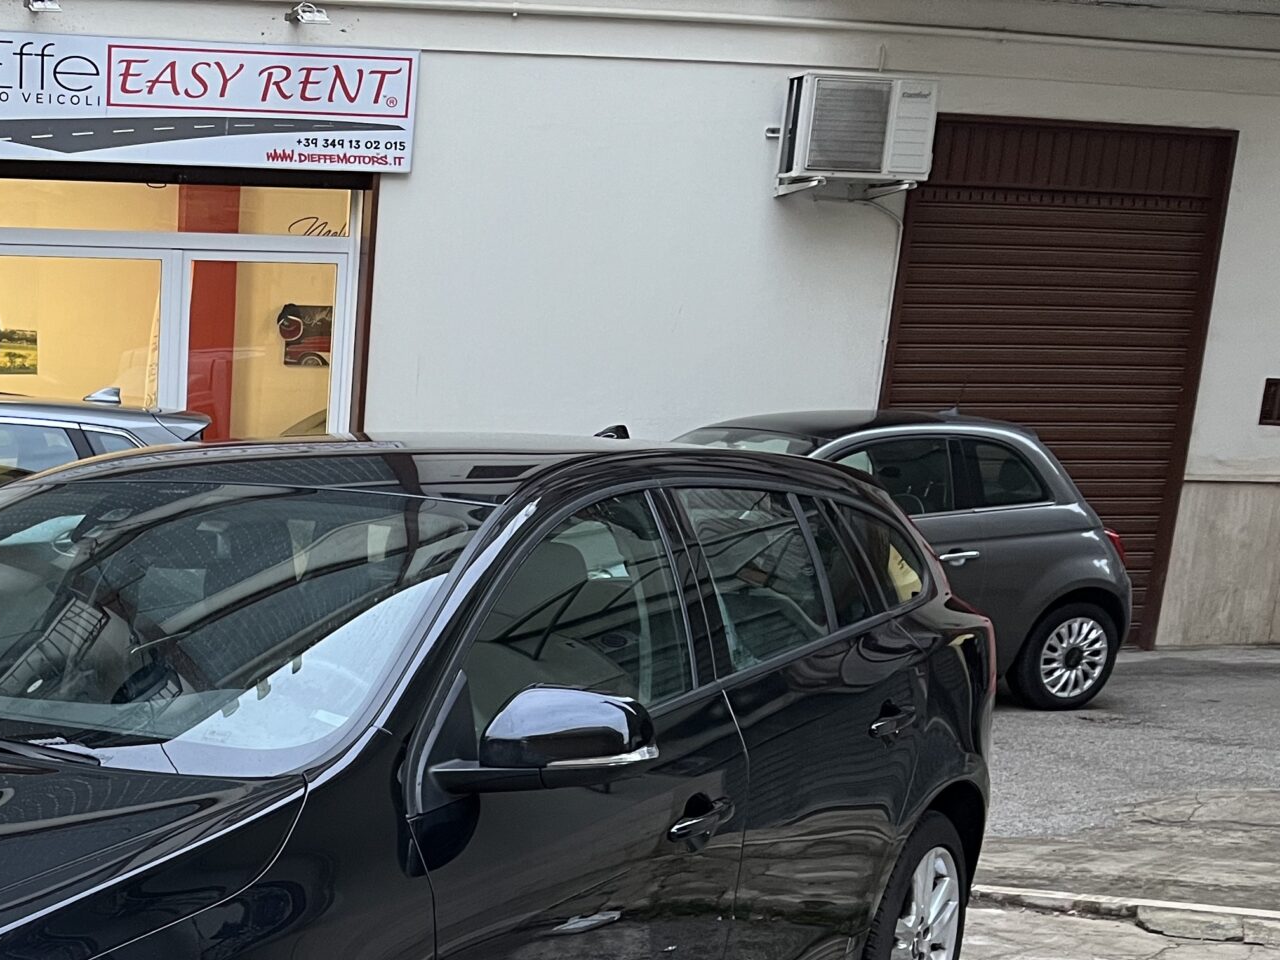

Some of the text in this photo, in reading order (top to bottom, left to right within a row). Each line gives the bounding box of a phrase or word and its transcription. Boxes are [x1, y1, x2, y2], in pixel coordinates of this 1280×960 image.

[117, 58, 245, 99] EASY
[22, 92, 101, 106] VEICOLI
[296, 138, 406, 151] +39 349 13 02 015
